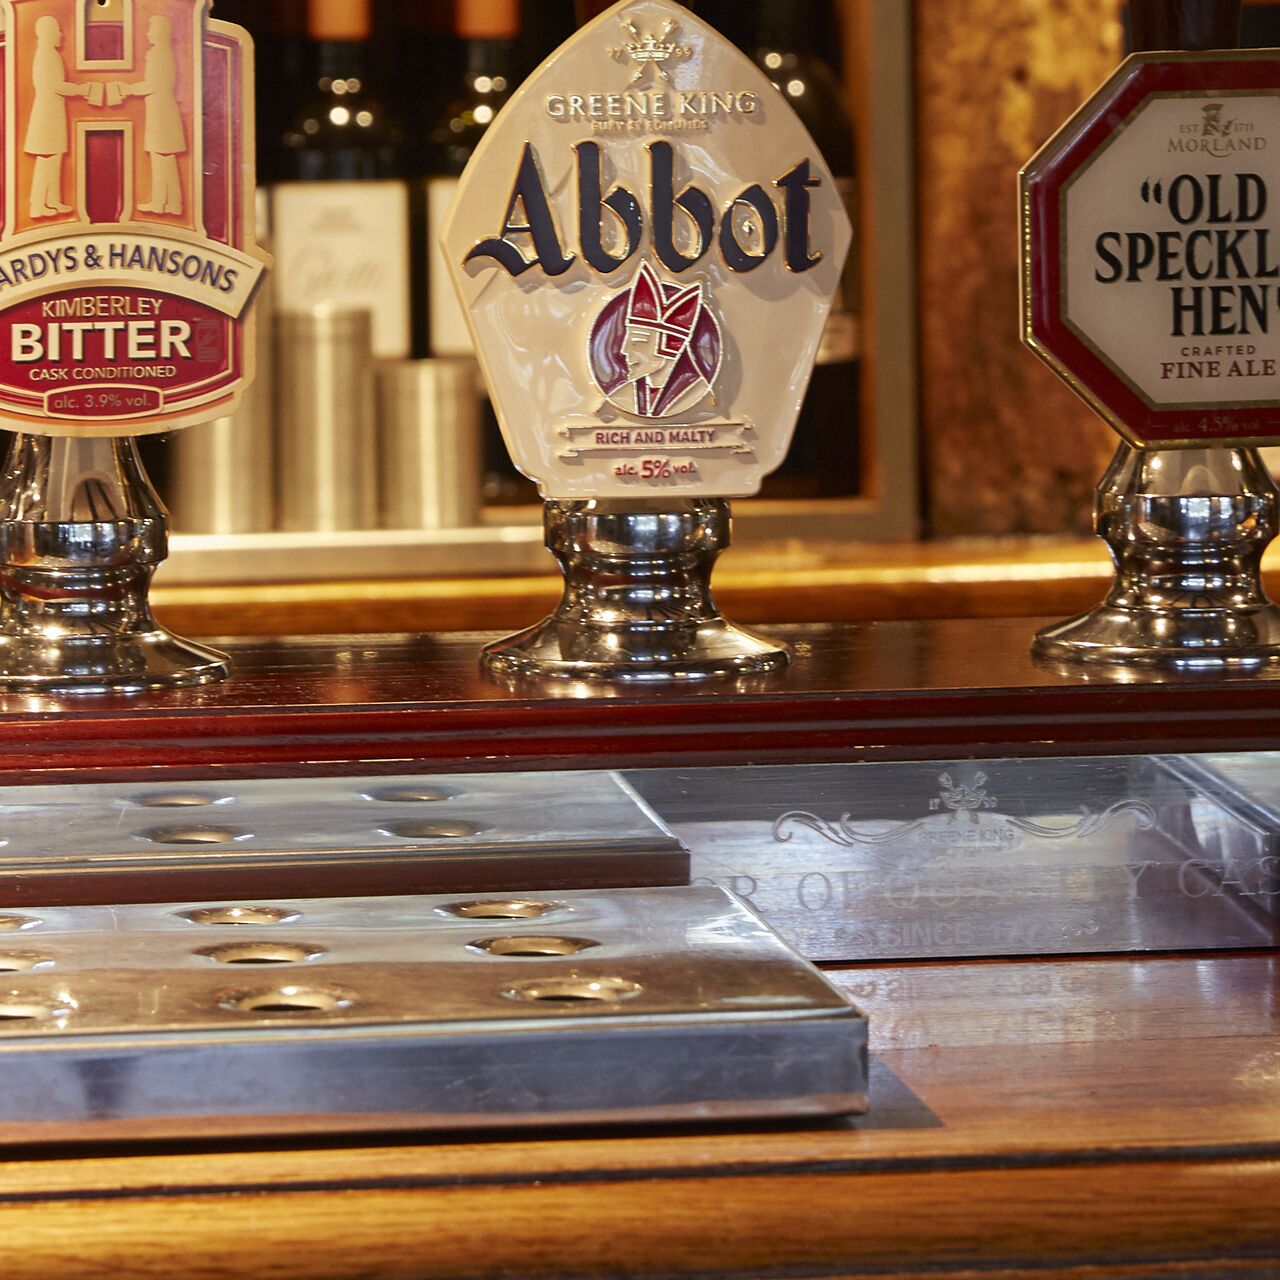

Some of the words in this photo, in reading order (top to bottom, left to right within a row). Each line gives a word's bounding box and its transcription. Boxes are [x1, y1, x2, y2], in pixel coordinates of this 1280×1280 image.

[545, 93, 666, 117] GREENE
[680, 90, 757, 115] KING
[1167, 137, 1267, 157] MORLAND
[461, 139, 824, 278] Abbot
[84, 244, 102, 270] &
[108, 243, 239, 294] HANSONS
[41, 296, 163, 318] KIMBERLEY
[11, 320, 192, 363] BITTER
[1180, 345, 1257, 357] CRAFTED
[29, 366, 69, 381] CASK
[72, 365, 177, 381] CONDITIONED
[1160, 360, 1221, 380] FINE
[1227, 359, 1277, 378] ALE
[54, 392, 79, 409] alc.
[84, 393, 121, 409] 3.9%
[125, 392, 152, 407] vol.
[595, 432, 630, 445] RICH
[634, 431, 664, 444] AND
[669, 430, 716, 443] MALTY
[614, 463, 638, 476] alc.
[641, 459, 671, 479] 5%
[980, 828, 1015, 842] KING
